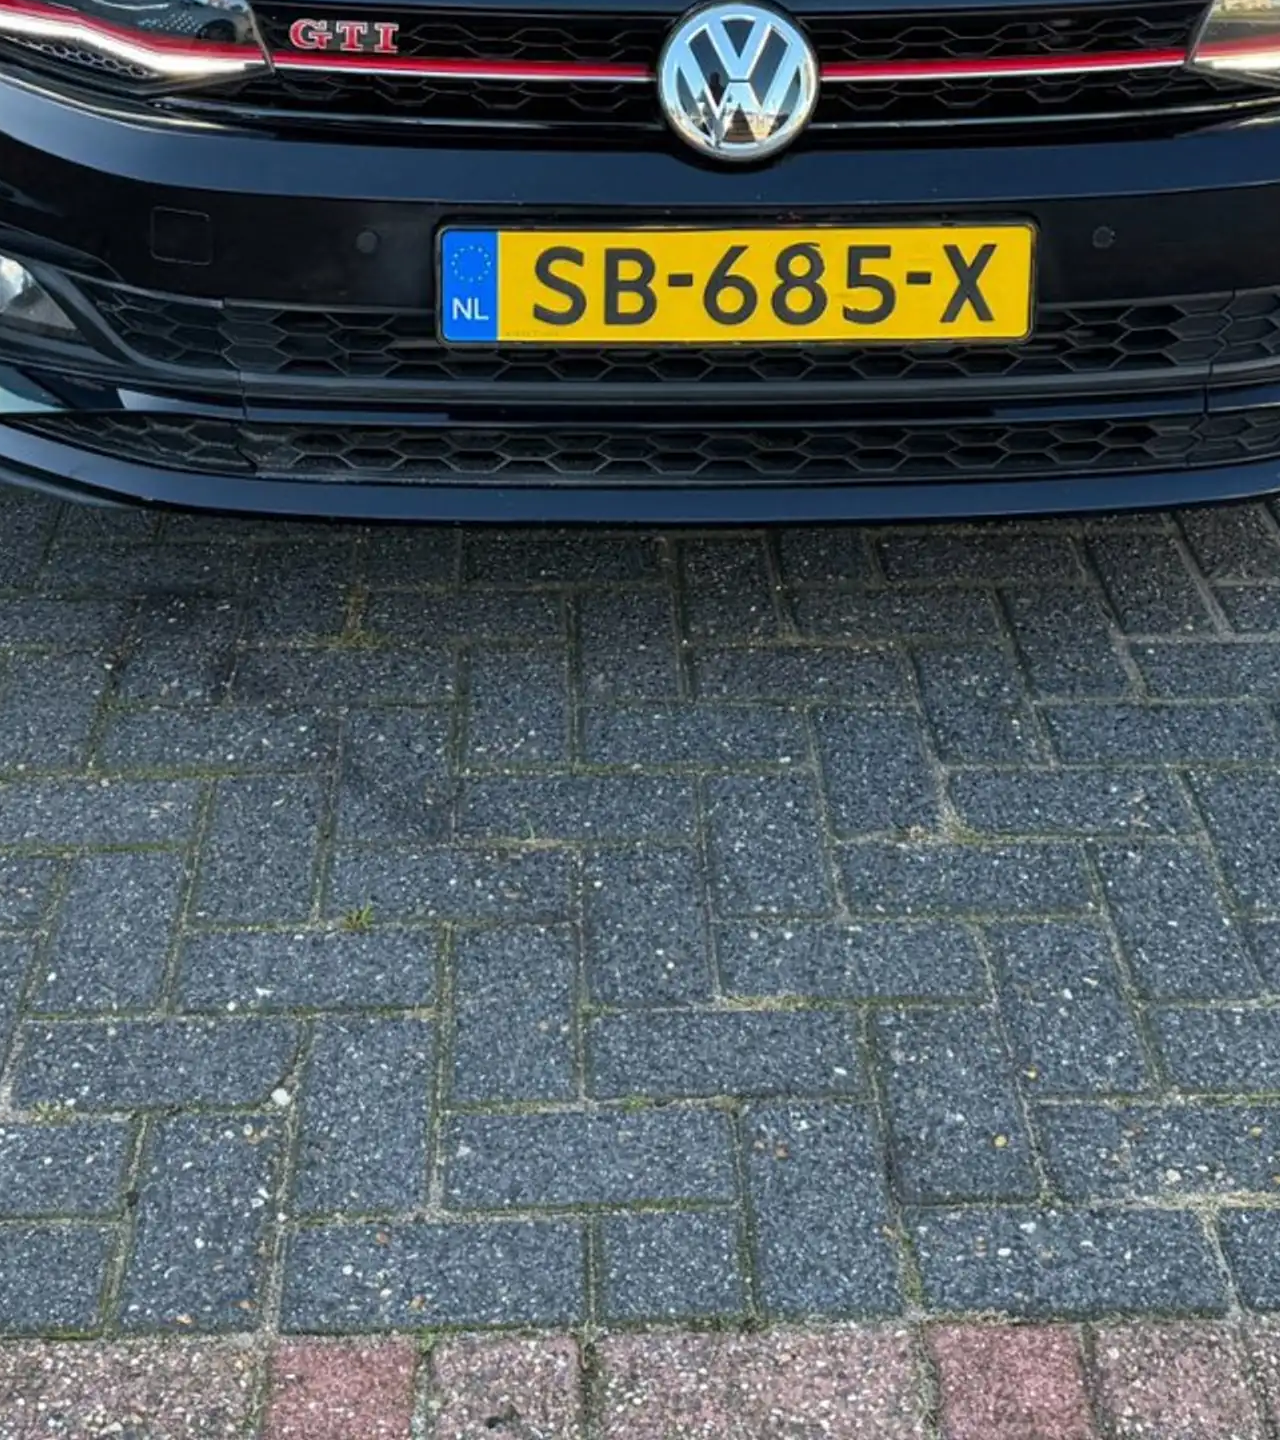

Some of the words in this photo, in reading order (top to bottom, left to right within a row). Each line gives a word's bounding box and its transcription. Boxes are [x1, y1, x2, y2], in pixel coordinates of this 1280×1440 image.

[288, 18, 400, 54] GTI
[451, 298, 489, 321] NL
[532, 242, 998, 327] SB-685-X
